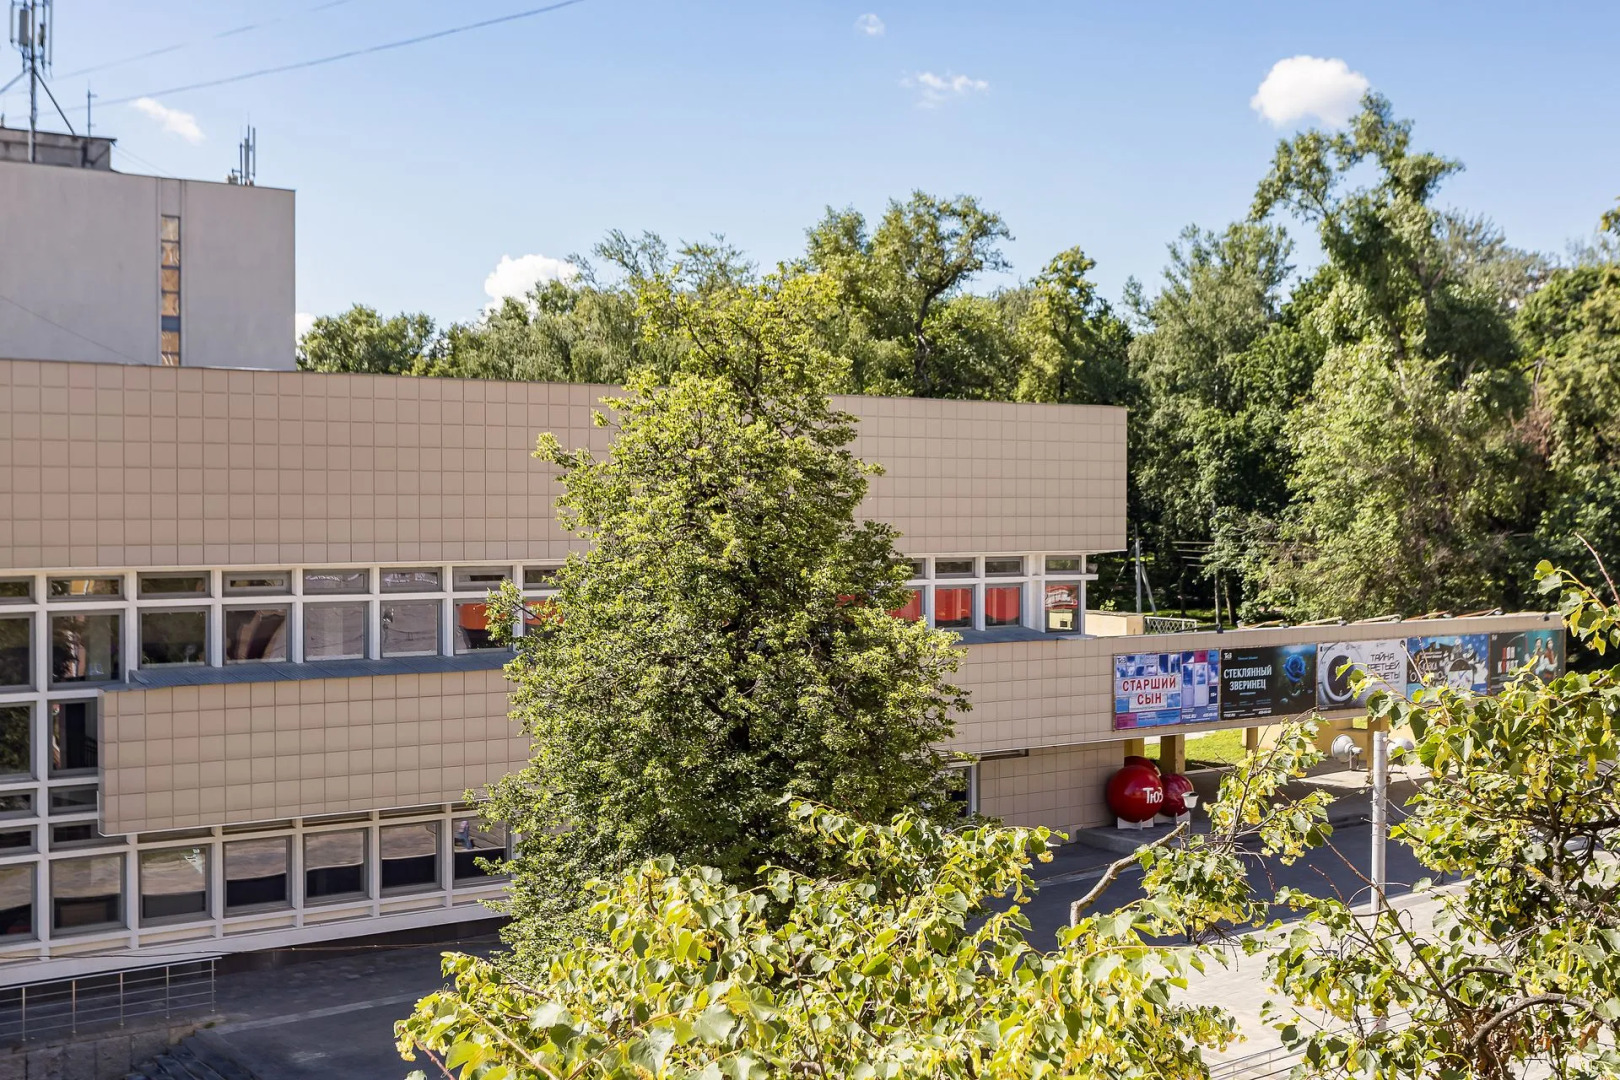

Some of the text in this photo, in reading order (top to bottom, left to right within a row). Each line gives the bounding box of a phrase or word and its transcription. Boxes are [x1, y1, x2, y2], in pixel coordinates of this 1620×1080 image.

[1370, 651, 1395, 662] ТАЙНА
[1223, 665, 1272, 679] СТЕКЛЯННЫЙ
[1122, 675, 1176, 692] СТАРШИЙ
[1229, 678, 1267, 691] ЗВЕРИНЕЦ
[1137, 692, 1162, 705] СЫН
